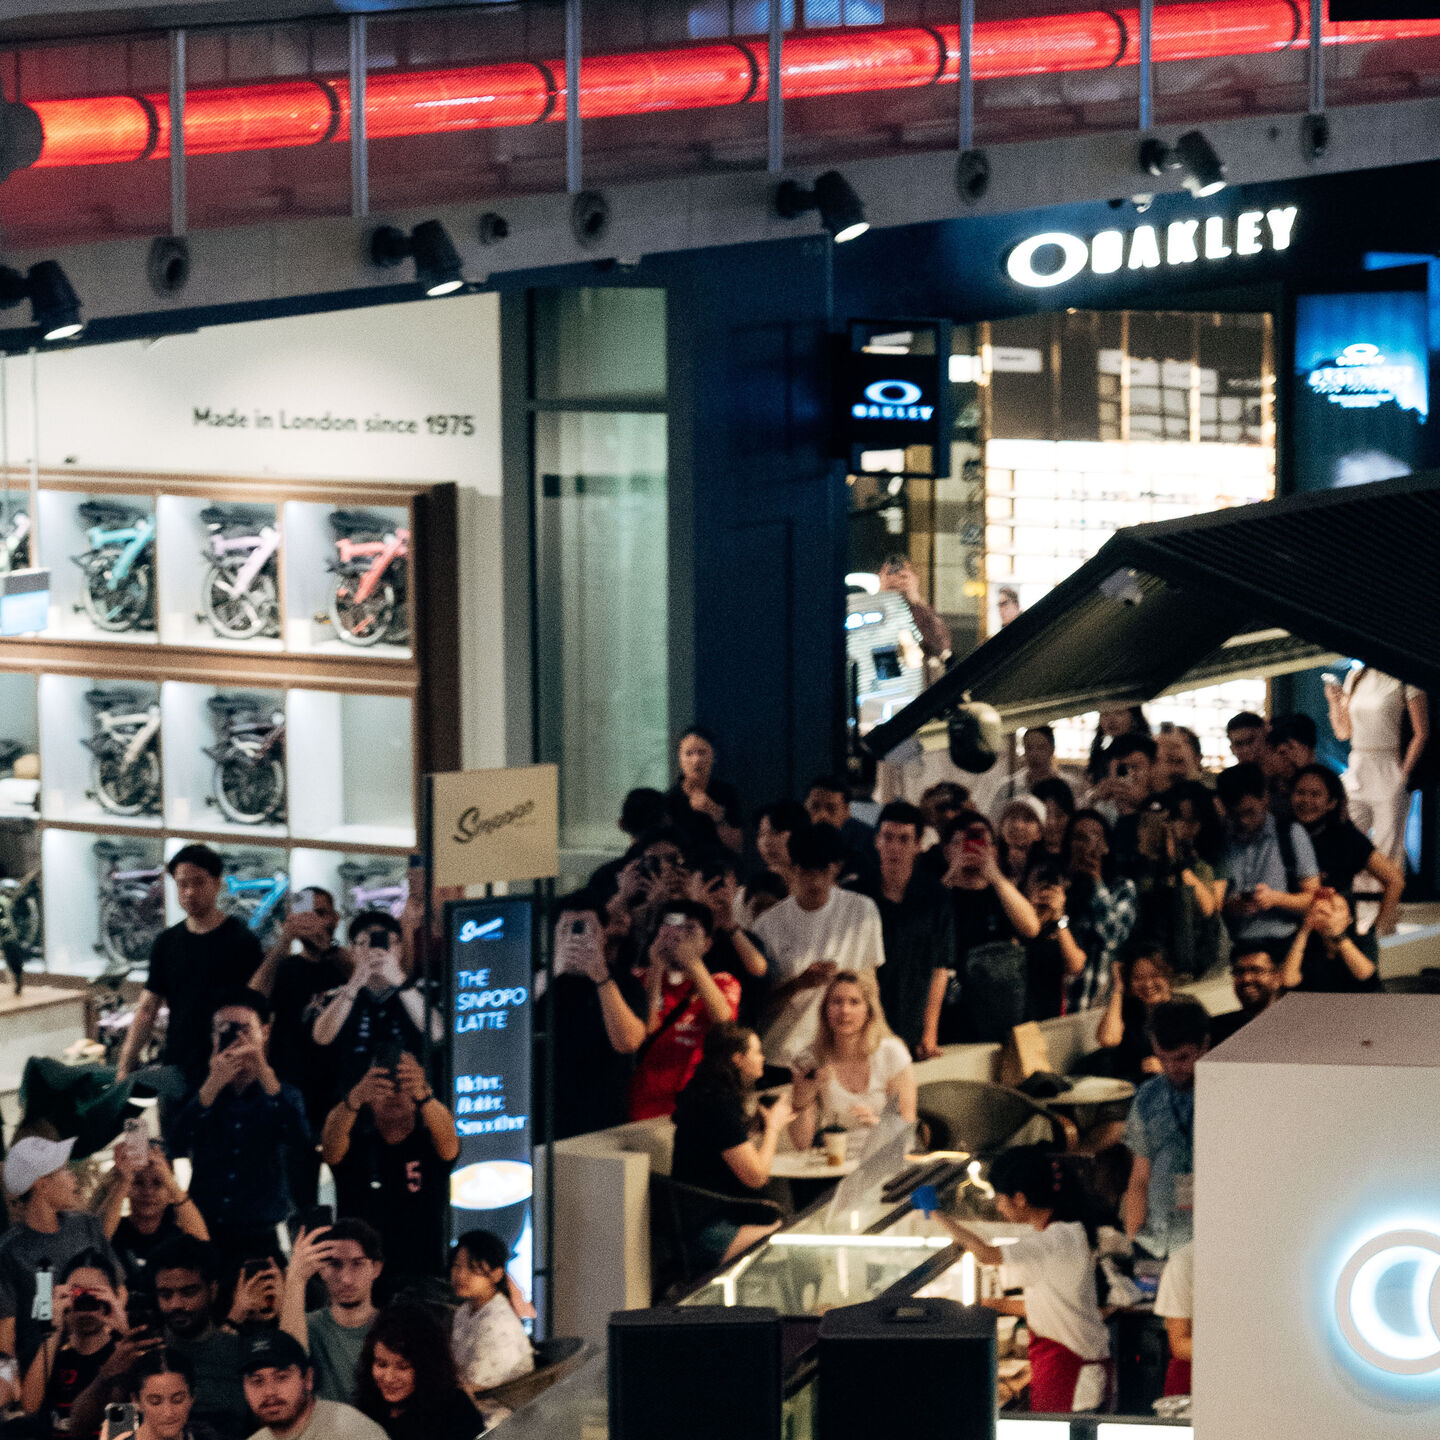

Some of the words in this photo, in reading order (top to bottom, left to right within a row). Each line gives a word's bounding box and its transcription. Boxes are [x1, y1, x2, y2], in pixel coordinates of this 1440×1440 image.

[1091, 206, 1298, 275] OAKLEY
[193, 406, 248, 429] Made
[254, 408, 274, 429] in
[279, 408, 358, 432] London
[364, 413, 418, 435] since
[425, 414, 476, 437] 1975
[456, 967, 491, 989] THE
[454, 1010, 509, 1034] LATTE
